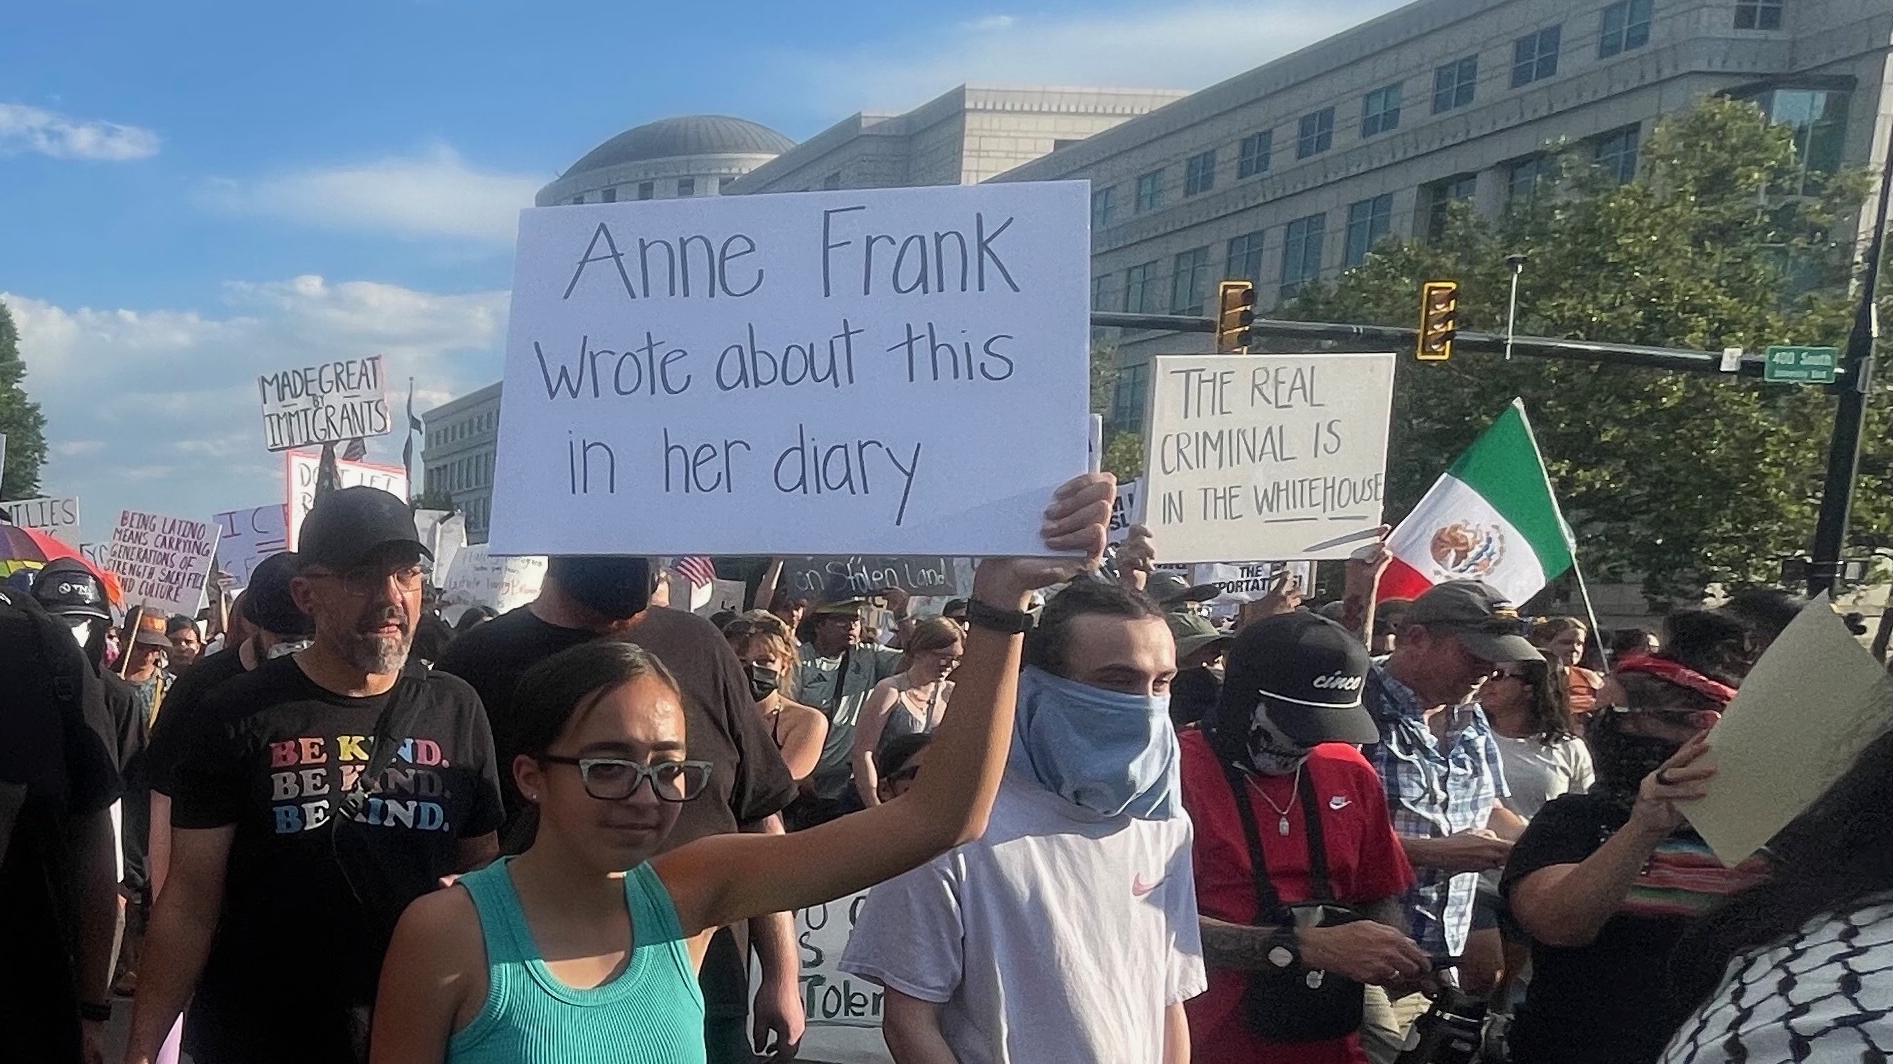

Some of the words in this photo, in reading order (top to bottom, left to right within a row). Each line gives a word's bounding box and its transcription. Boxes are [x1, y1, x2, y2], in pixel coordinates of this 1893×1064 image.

[563, 221, 764, 299] Anne
[715, 318, 865, 391] about
[886, 321, 1014, 384] this
[1169, 367, 1235, 420] THE
[1251, 364, 1325, 409] REAL
[265, 398, 387, 447] IMMIGRANTS
[1160, 424, 1298, 476] CRIMINAL
[1313, 418, 1342, 459] IS
[568, 429, 615, 495] in
[663, 427, 751, 494] her
[773, 423, 921, 526] diary
[1161, 489, 1184, 526] IN
[1198, 485, 1243, 522] THE
[113, 527, 149, 549] MEANS
[154, 533, 211, 558] CARRYING
[120, 510, 157, 533] BEING
[161, 517, 207, 541] LATINO
[110, 542, 175, 569] GENERATIONS
[178, 556, 198, 571] OF
[1239, 566, 1263, 578] THE
[137, 580, 183, 604] CULTURE
[1312, 670, 1362, 691] cinco
[269, 737, 328, 768] BE
[270, 767, 330, 801] BE
[272, 799, 331, 834] BE
